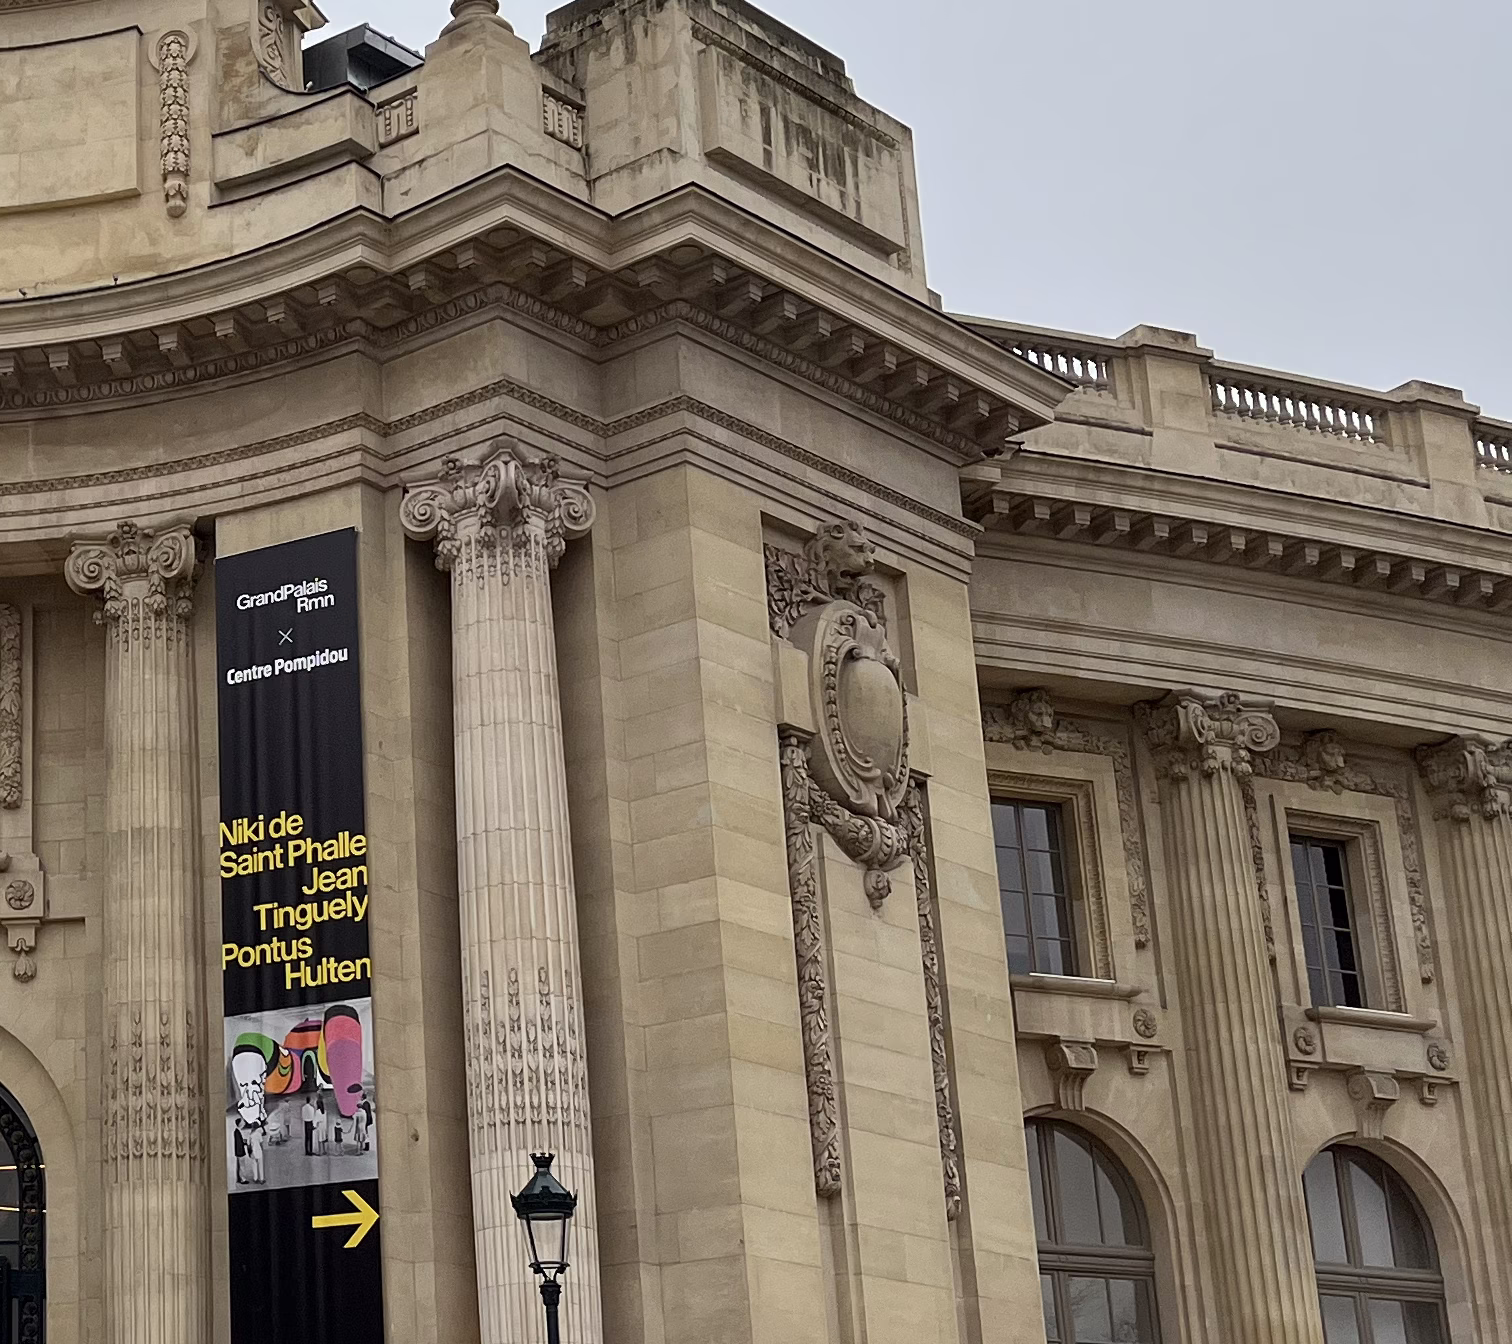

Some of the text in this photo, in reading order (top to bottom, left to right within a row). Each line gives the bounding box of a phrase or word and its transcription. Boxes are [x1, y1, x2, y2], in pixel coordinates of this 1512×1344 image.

[296, 594, 335, 613] Rmn
[226, 647, 348, 685] Centre Pompidou
[219, 810, 304, 848] Niki de
[219, 830, 367, 879] Saint Phalle
[301, 865, 369, 895] Jean
[252, 890, 369, 931] Tinguely
[220, 936, 313, 971] Pontus
[284, 956, 372, 990] Hulten
